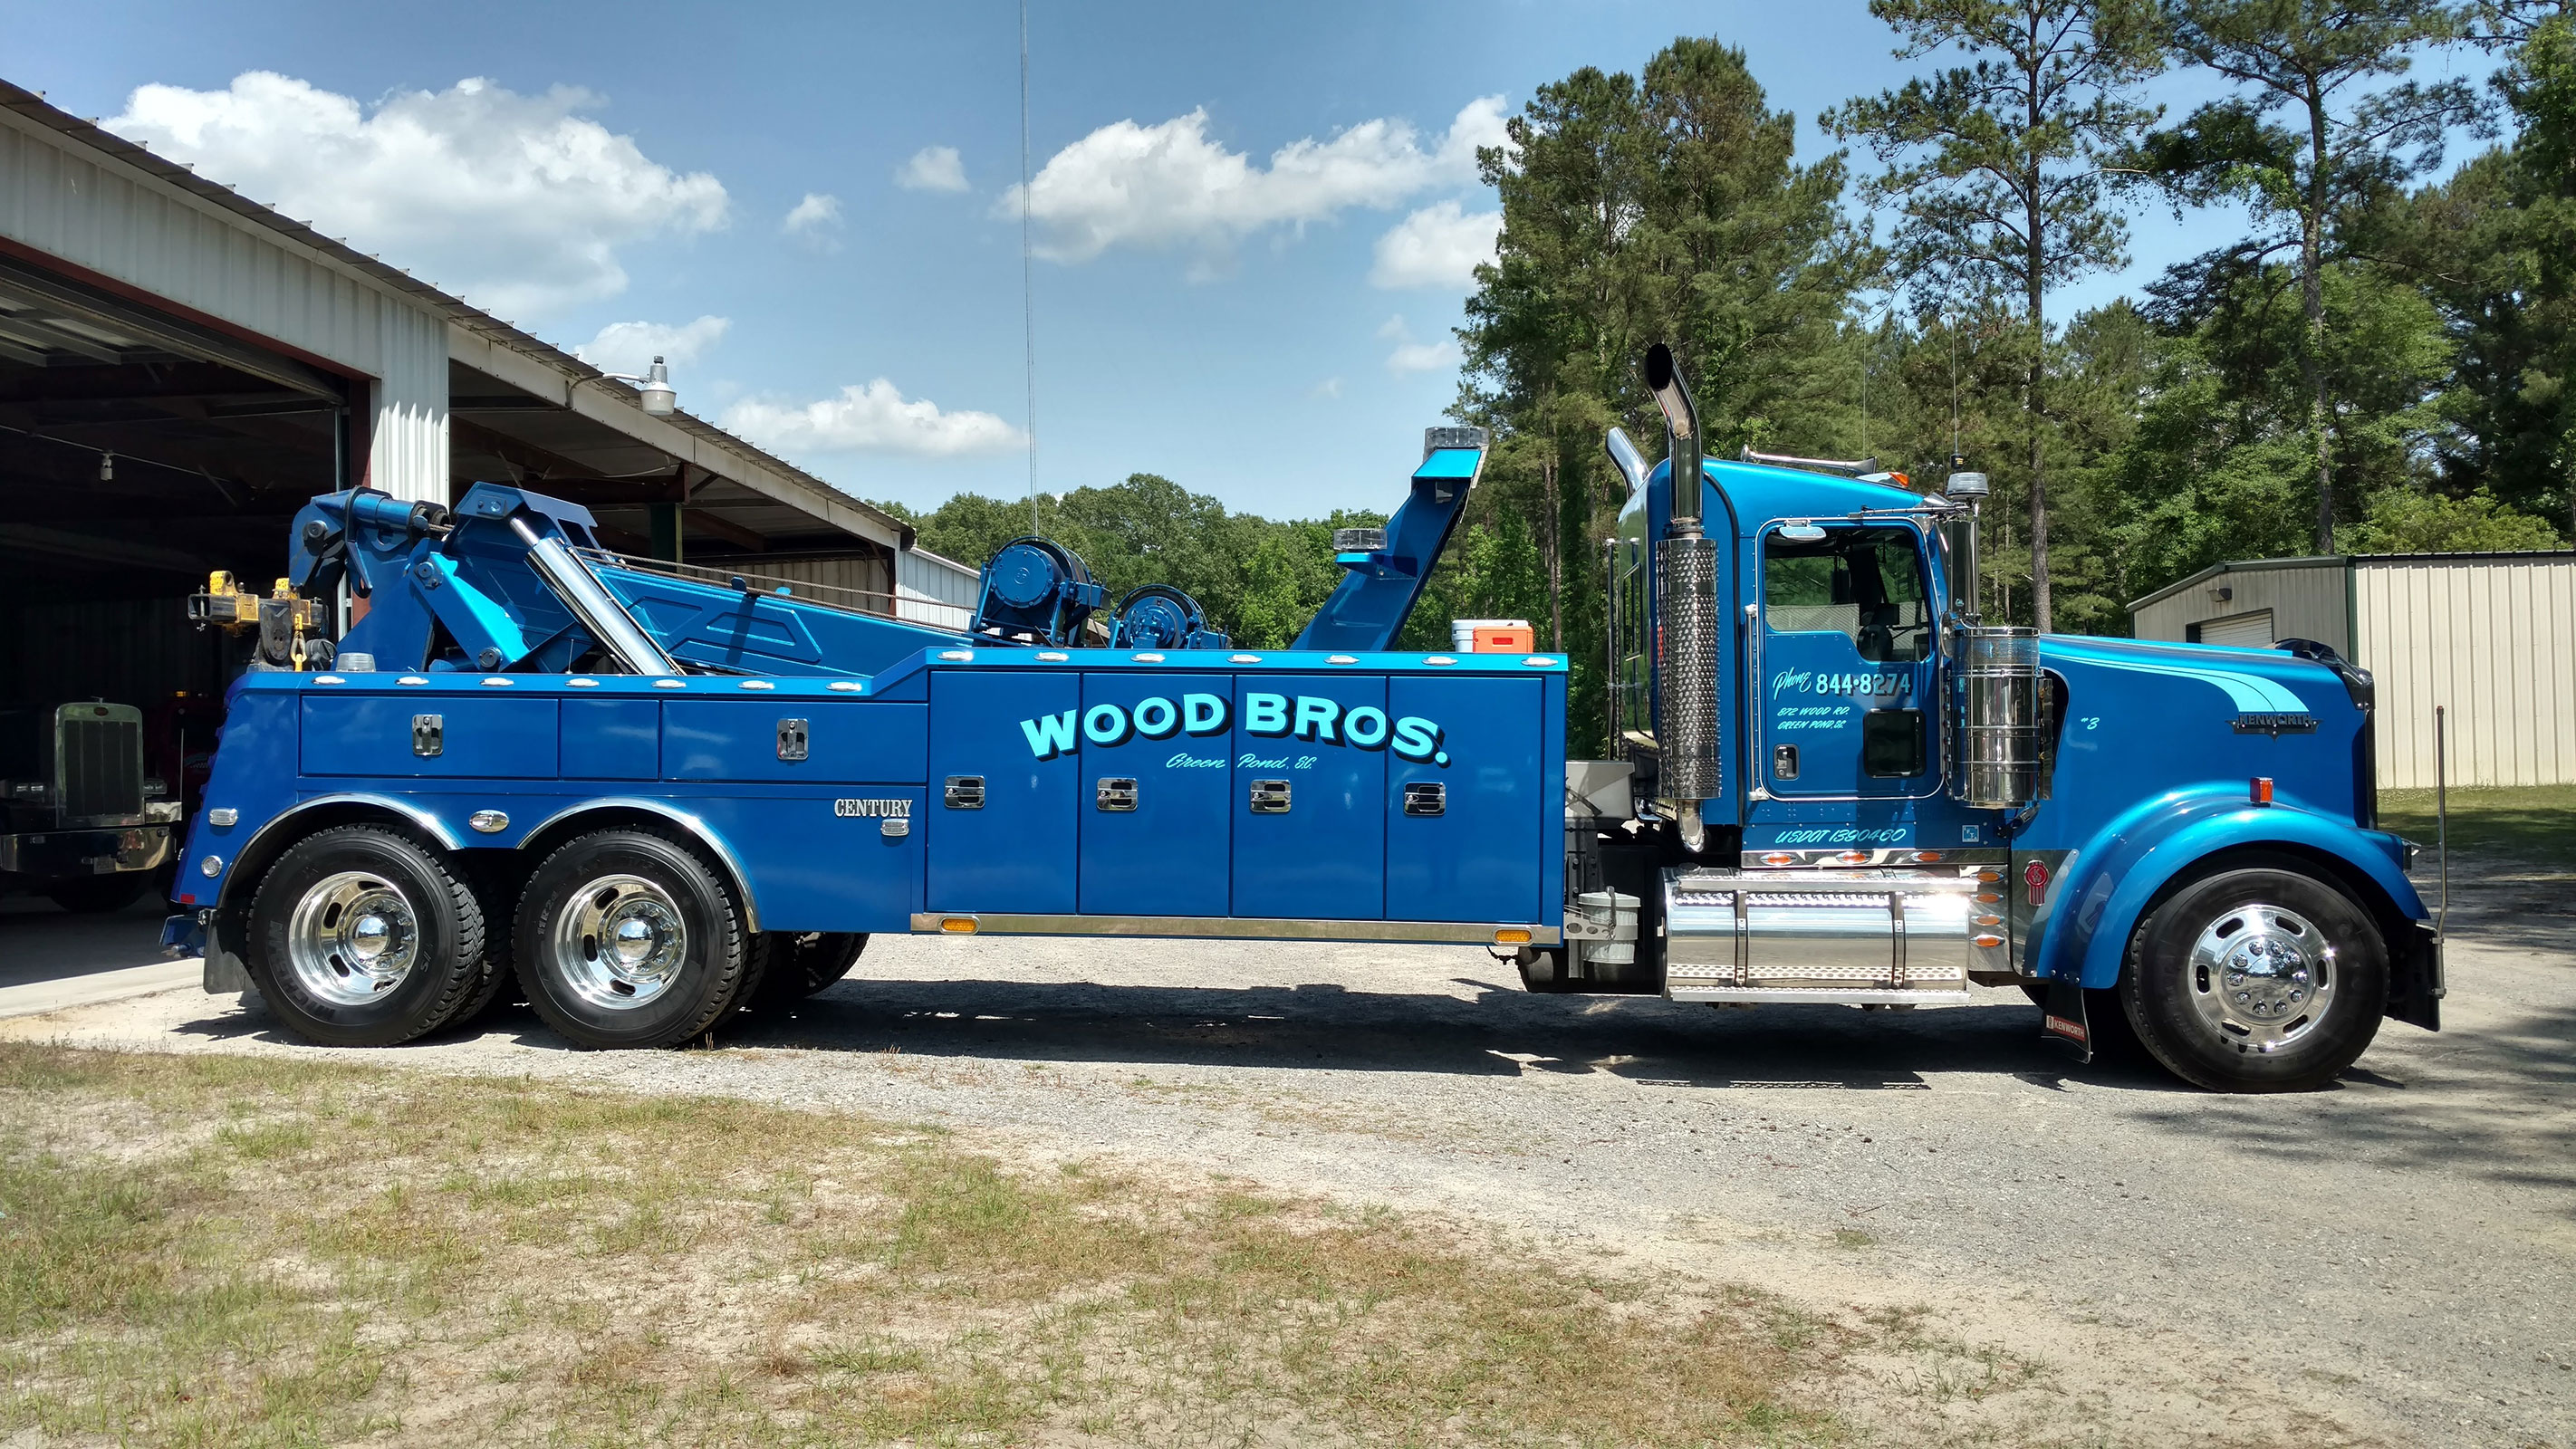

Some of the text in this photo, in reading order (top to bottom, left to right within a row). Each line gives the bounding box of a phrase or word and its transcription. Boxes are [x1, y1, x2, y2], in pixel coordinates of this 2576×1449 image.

[1773, 667, 1812, 701] Phone
[1777, 706, 1850, 716] 872 WOOD RD.
[1020, 692, 1451, 766] WOOD BROS.
[1777, 720, 1810, 730] GREEN
[2237, 714, 2312, 728] KENWORTH
[1166, 753, 1226, 769] Green
[1236, 753, 1290, 770] Pond,
[834, 798, 913, 818] CENTURY
[1774, 828, 1907, 844] USDOT 1390460
[2053, 1019, 2085, 1039] KENWORTH
